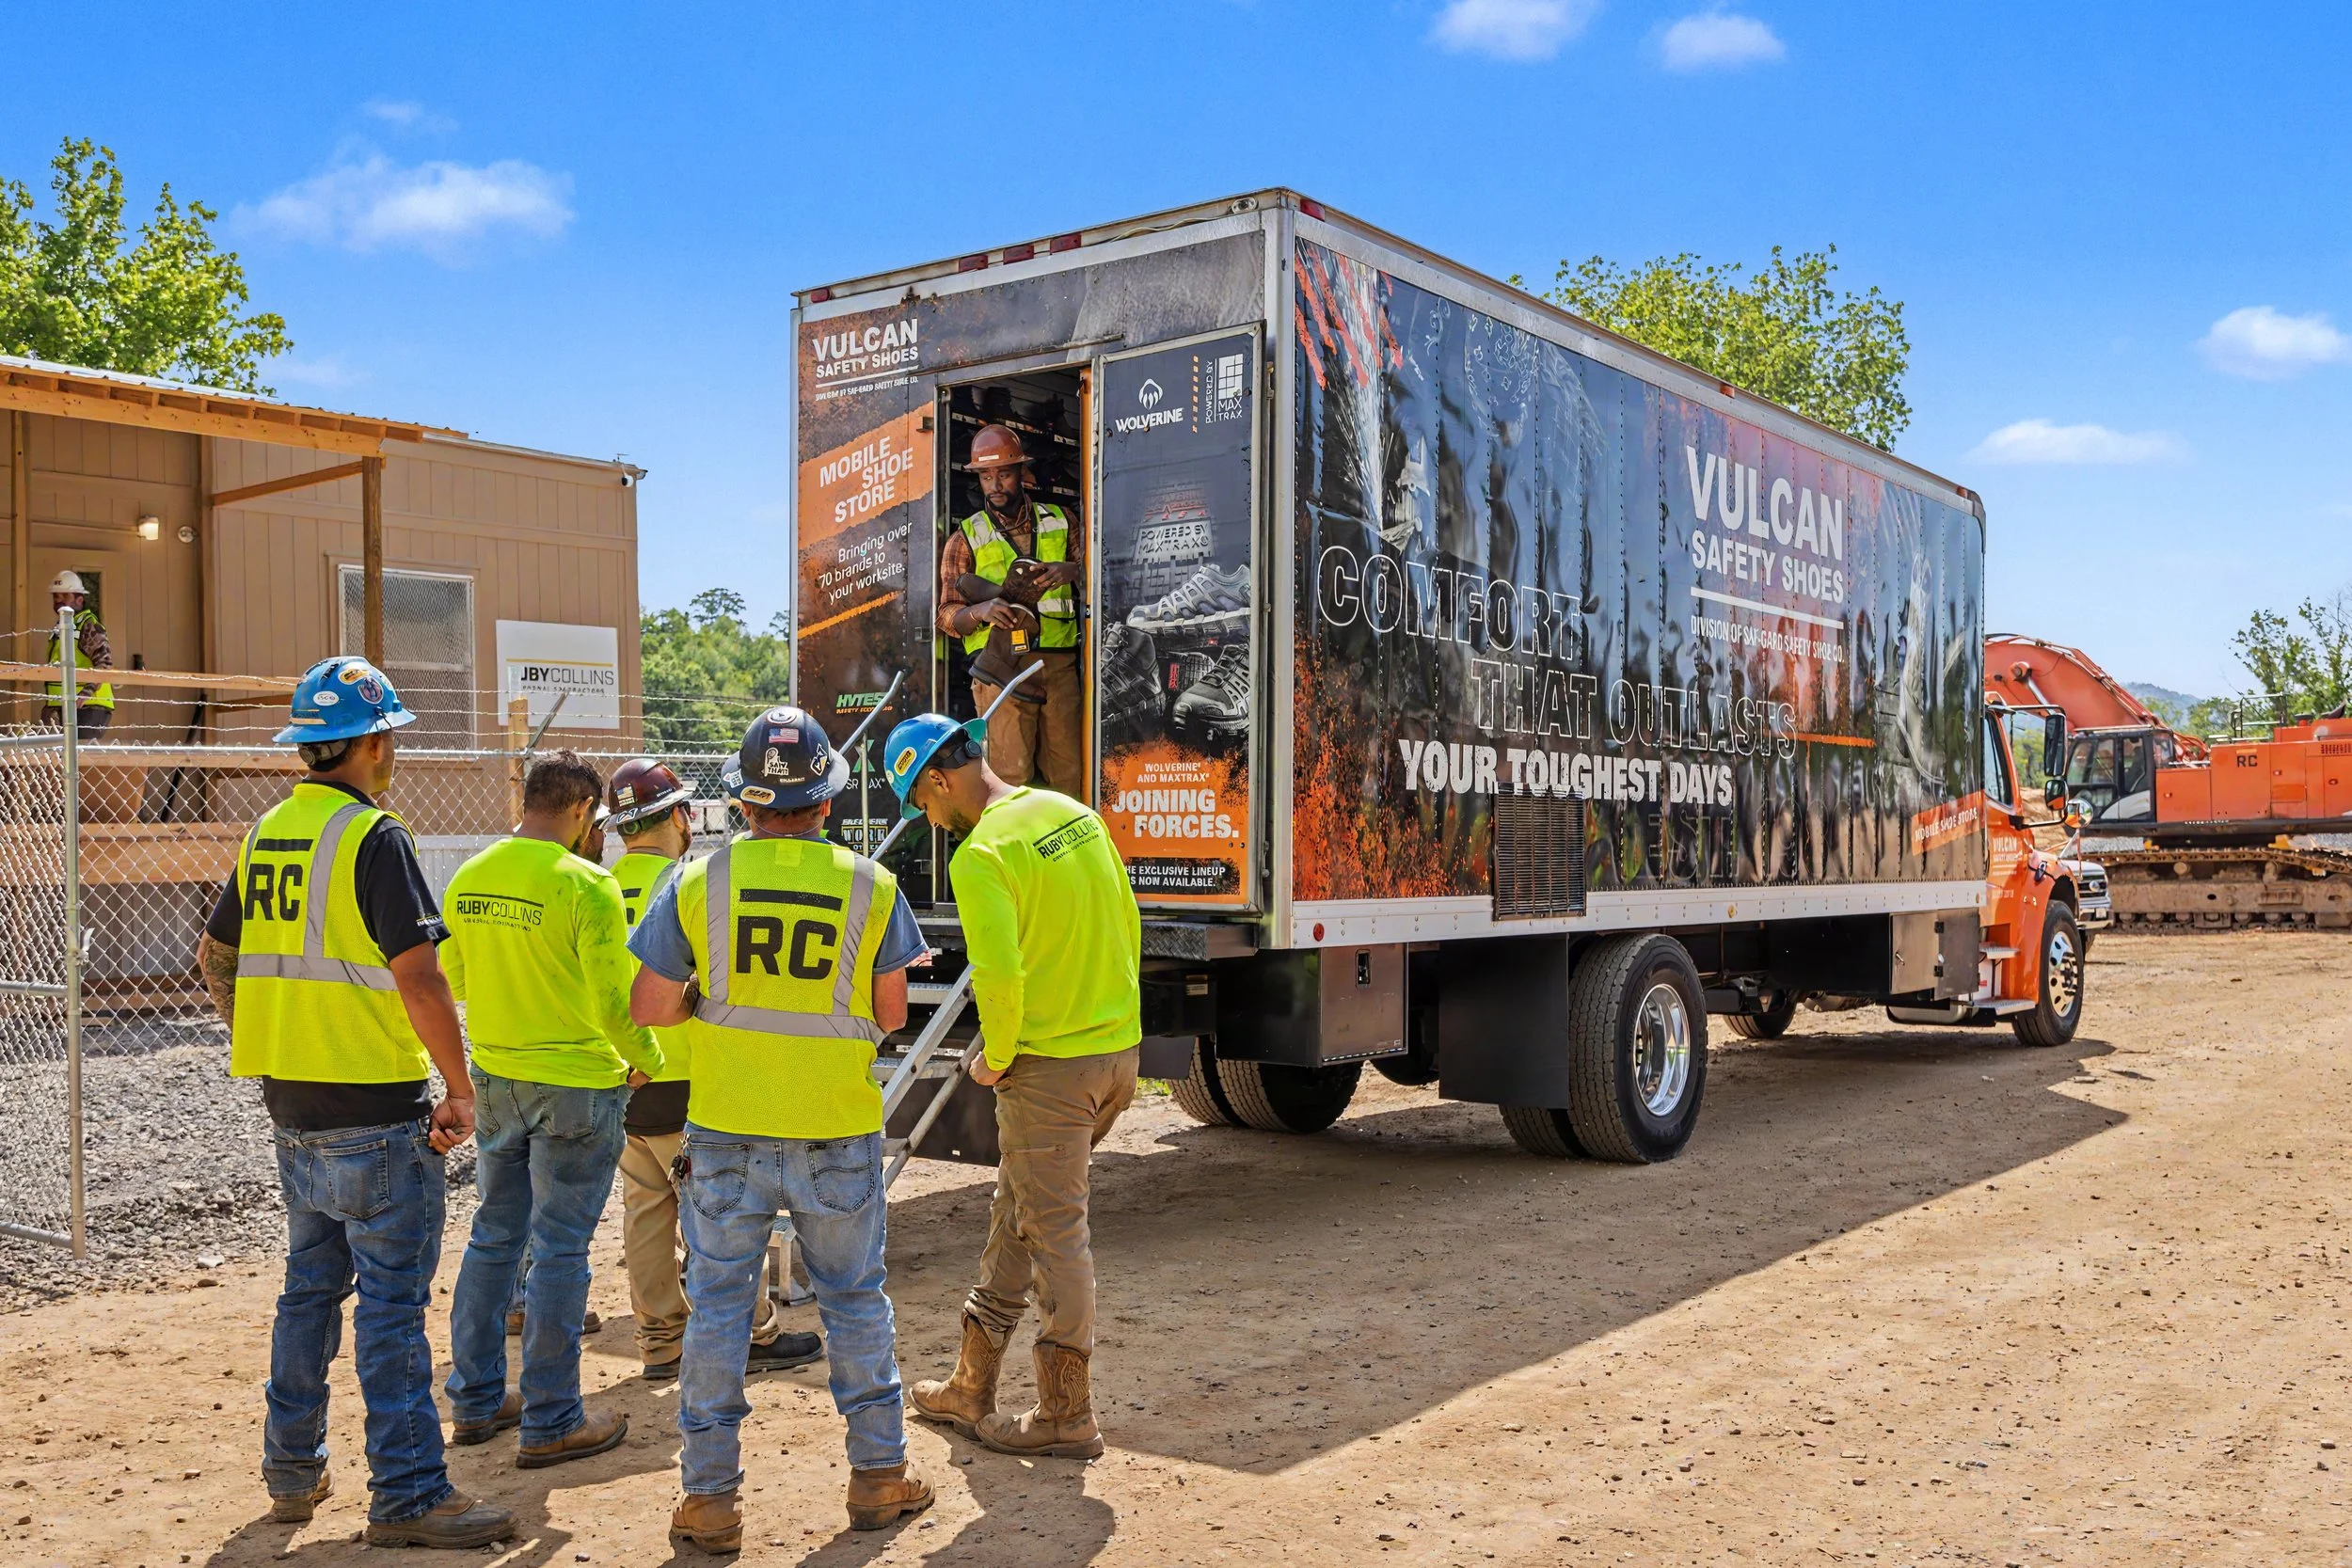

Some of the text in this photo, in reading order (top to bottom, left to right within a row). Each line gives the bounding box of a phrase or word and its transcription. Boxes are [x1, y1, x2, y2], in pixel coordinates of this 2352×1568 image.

[812, 318, 918, 362] VULCAN
[816, 345, 919, 379] SAFETY SHOES
[1115, 406, 1184, 433] WOLVERINE
[1205, 375, 1214, 424] POWERED
[1218, 397, 1243, 412] MAX
[1218, 409, 1243, 421] TRAX
[819, 436, 891, 488] MOBILE
[861, 447, 914, 489] SHOE
[834, 478, 895, 523] STORE
[1686, 444, 1843, 562] VULCAN
[838, 522, 913, 563] Bringing over
[819, 552, 886, 589] 70 brands to
[829, 562, 906, 606] your worksite.
[1692, 529, 1844, 604] SAFETY SHOES
[1317, 545, 1581, 661] COMFORT
[1691, 614, 1729, 642] DIVISION
[1471, 657, 1798, 759] THAT OUTLASTS
[1136, 773, 1157, 784] AND
[1398, 738, 1733, 807] YOUR TOUGHEST DAYS
[2236, 754, 2258, 768] RC
[1111, 788, 1216, 814] JOINING
[1134, 814, 1240, 839] FORCES.
[1125, 865, 1226, 877] HE EXCLUSIVE LINEUP
[1138, 877, 1160, 886] NOW
[1162, 877, 1216, 887] AVAILABLE.
[244, 863, 304, 922] RC
[736, 915, 837, 980] RC
